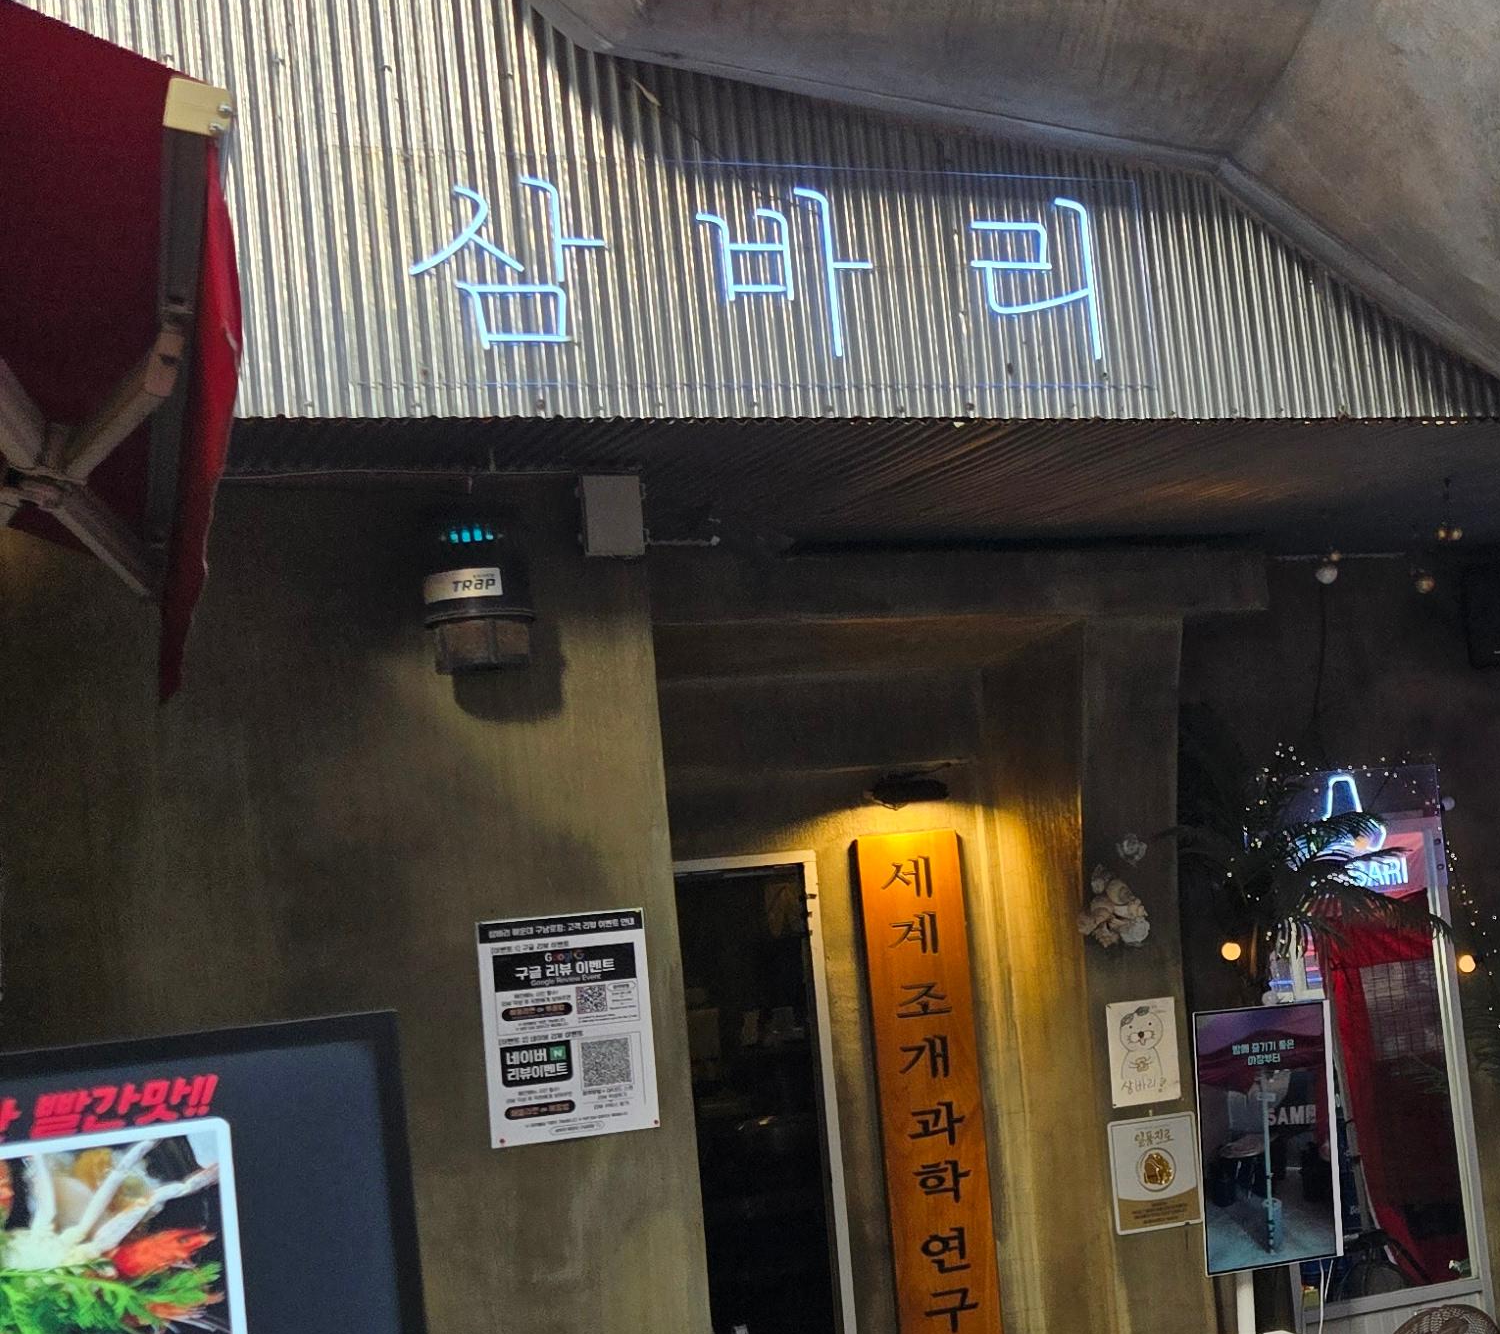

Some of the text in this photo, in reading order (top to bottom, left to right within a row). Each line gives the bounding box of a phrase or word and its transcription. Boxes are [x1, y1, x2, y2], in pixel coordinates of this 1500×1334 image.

[409, 176, 1103, 359] 삼바리
[515, 958, 616, 981] 구글 리뷰 이벤트
[506, 1048, 548, 1065] 네이버
[30, 1073, 219, 1140] 빨간맛!!
